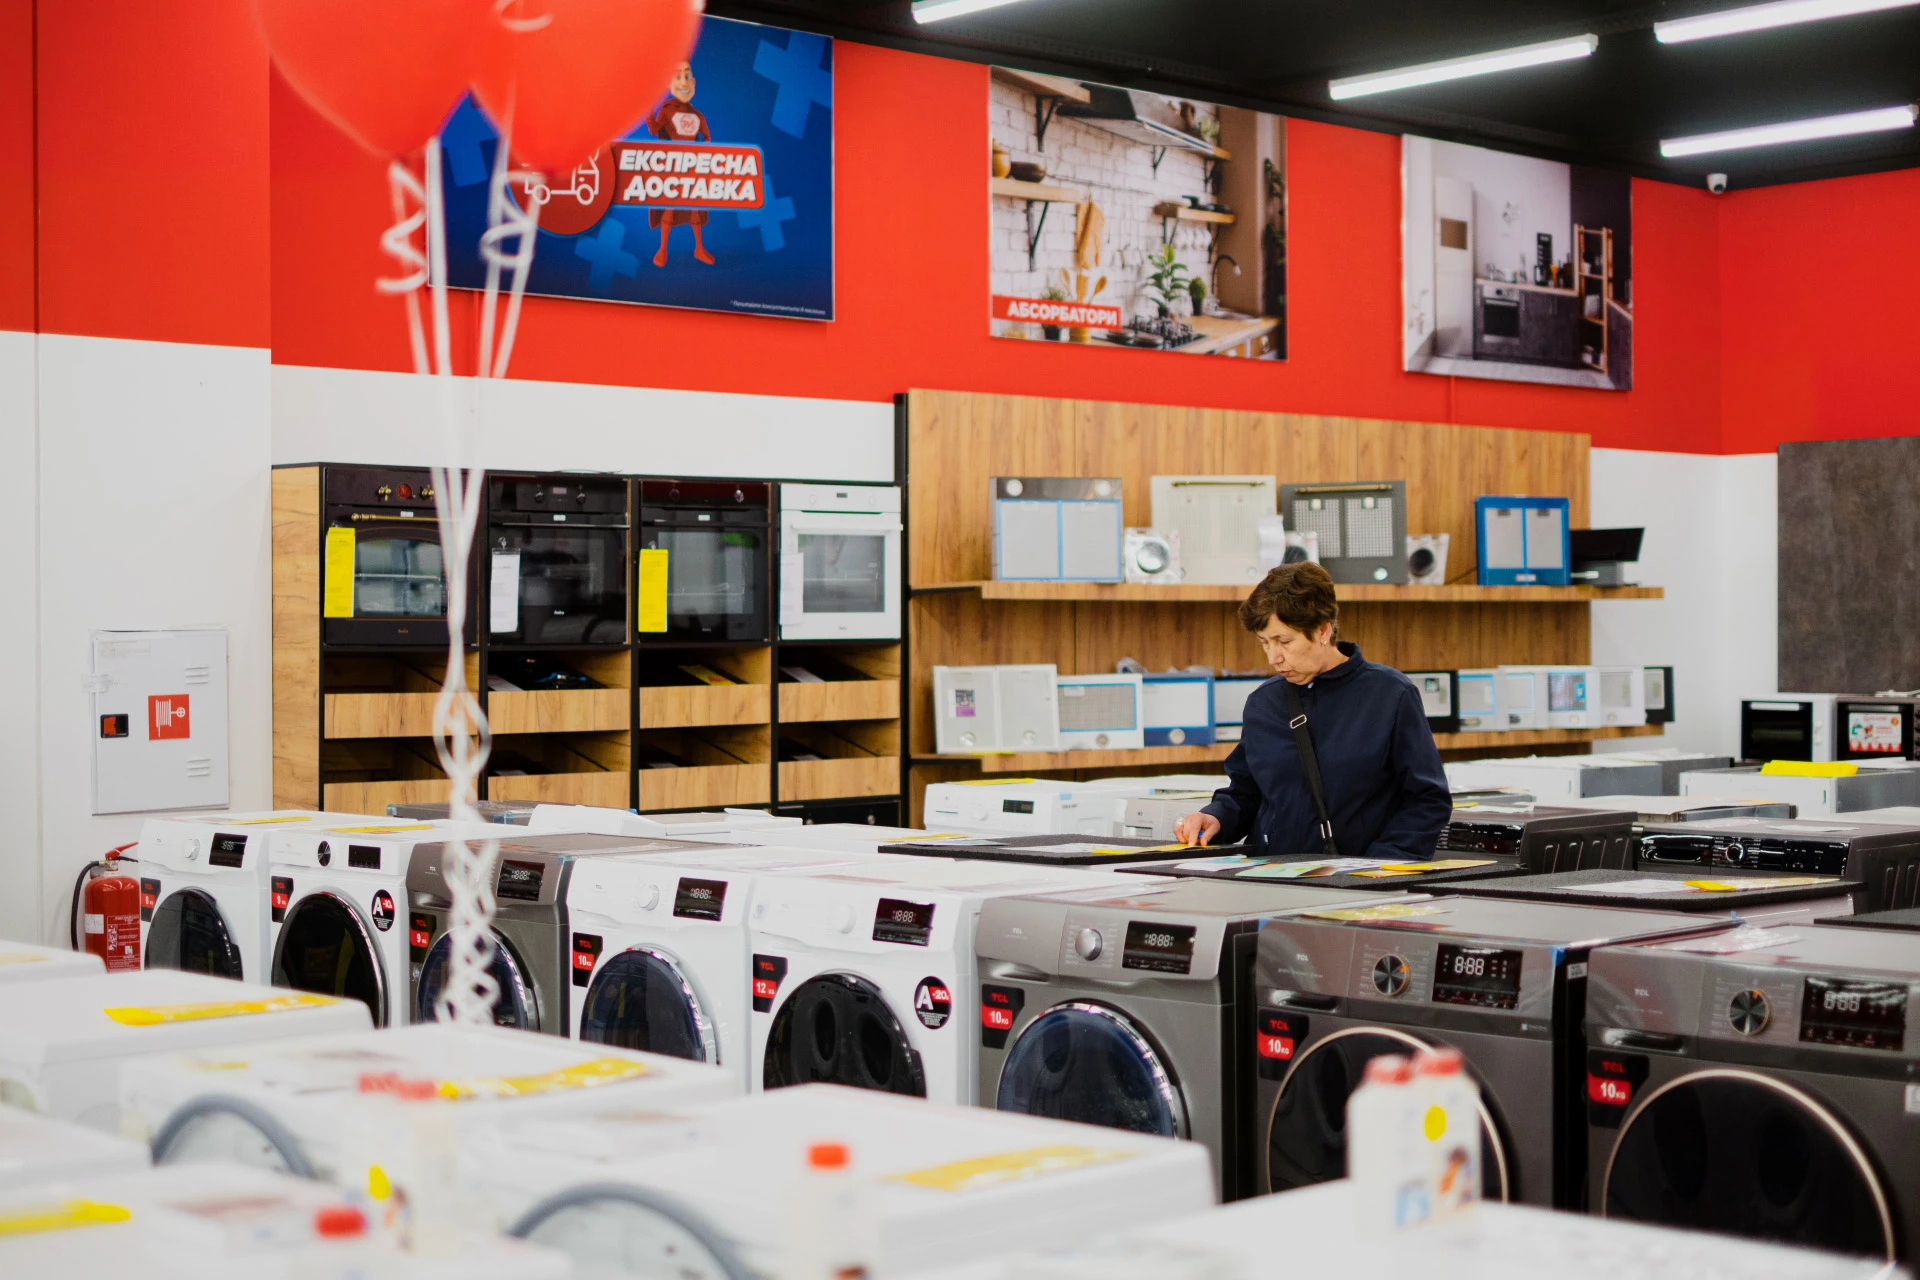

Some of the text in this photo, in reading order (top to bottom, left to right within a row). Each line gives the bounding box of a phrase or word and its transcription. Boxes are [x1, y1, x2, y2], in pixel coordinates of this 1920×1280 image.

[619, 149, 758, 176] ЕКСПРЕСНА
[623, 175, 756, 202] ДОСТАВКА
[1007, 301, 1118, 326] АБСОРБАТОРИ
[372, 896, 384, 917] A
[416, 933, 422, 944] 9
[579, 939, 593, 949] TCL
[1296, 953, 1309, 962] TCL
[759, 961, 775, 972] TCL
[756, 981, 766, 994] 12
[1635, 988, 1650, 997] TCL
[915, 984, 934, 1011] A
[991, 991, 1009, 1004] TCL
[1270, 1019, 1290, 1031] TCL
[1601, 1060, 1625, 1073] TCL
